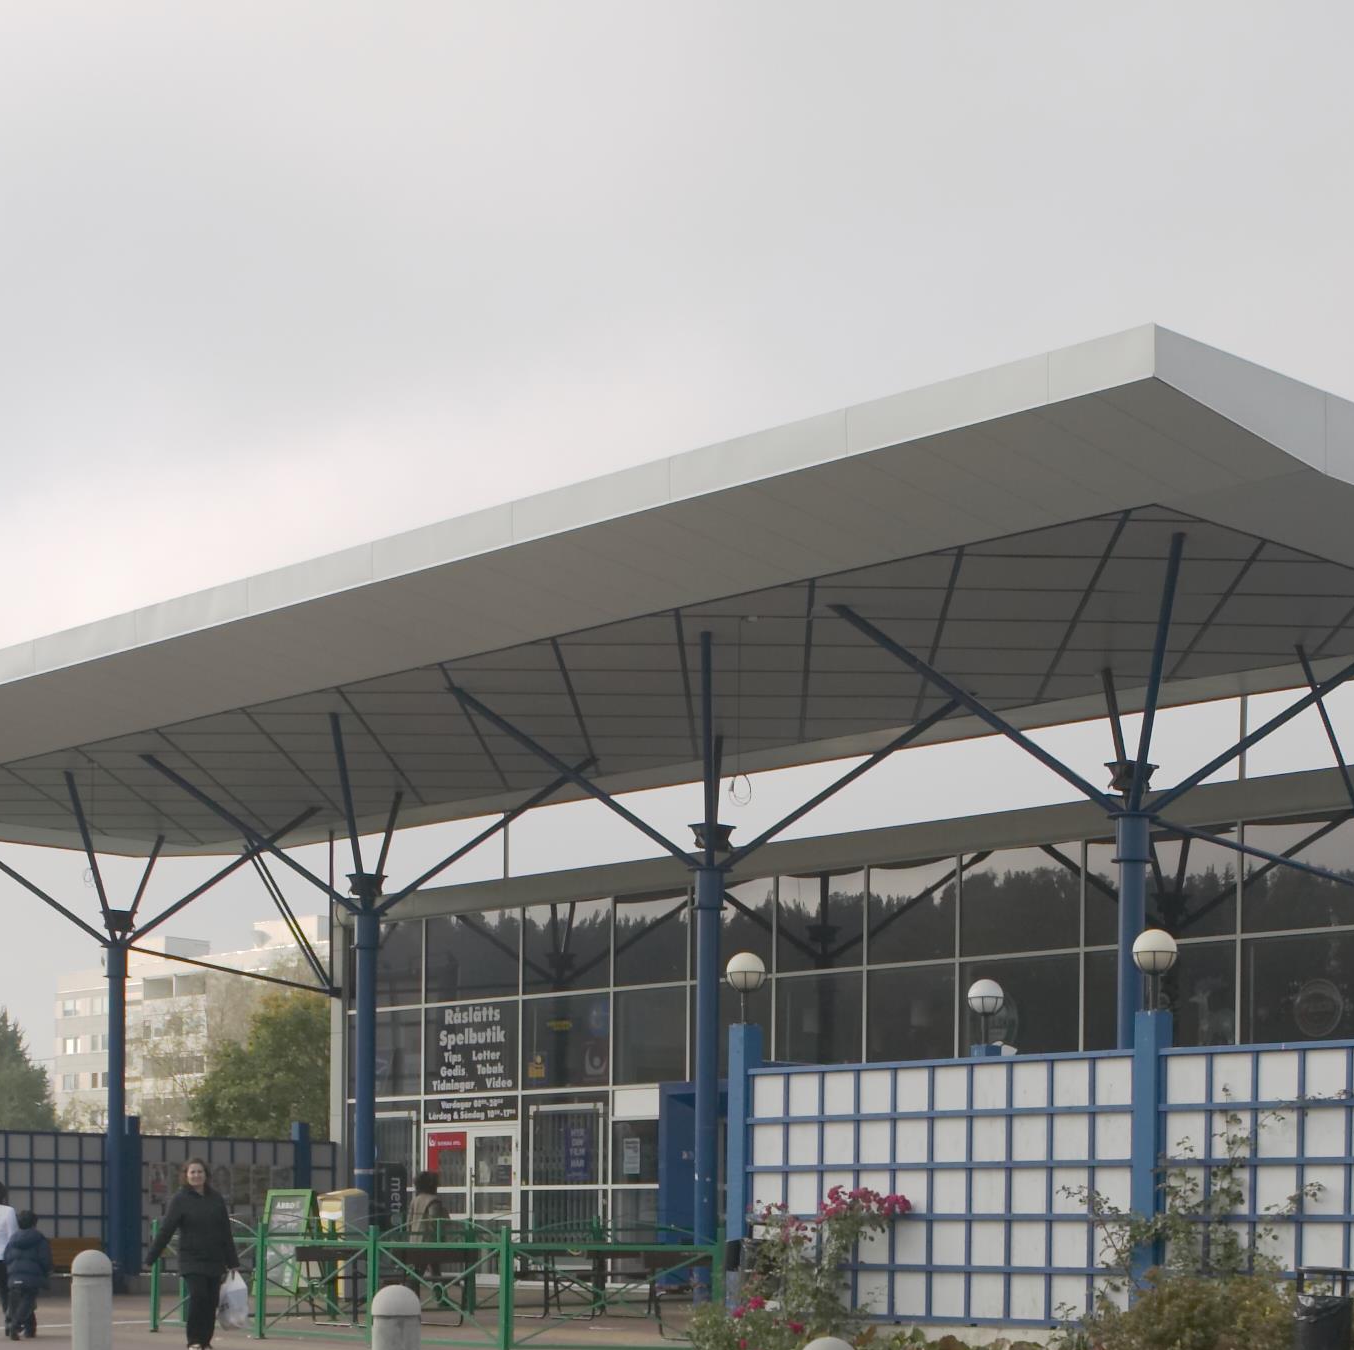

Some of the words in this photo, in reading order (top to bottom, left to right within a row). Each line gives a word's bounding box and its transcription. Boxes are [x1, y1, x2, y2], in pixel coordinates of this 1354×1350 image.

[444, 1006, 500, 1025] Råslätts
[439, 1026, 506, 1049] Spelbutik
[485, 1077, 513, 1088] Video
